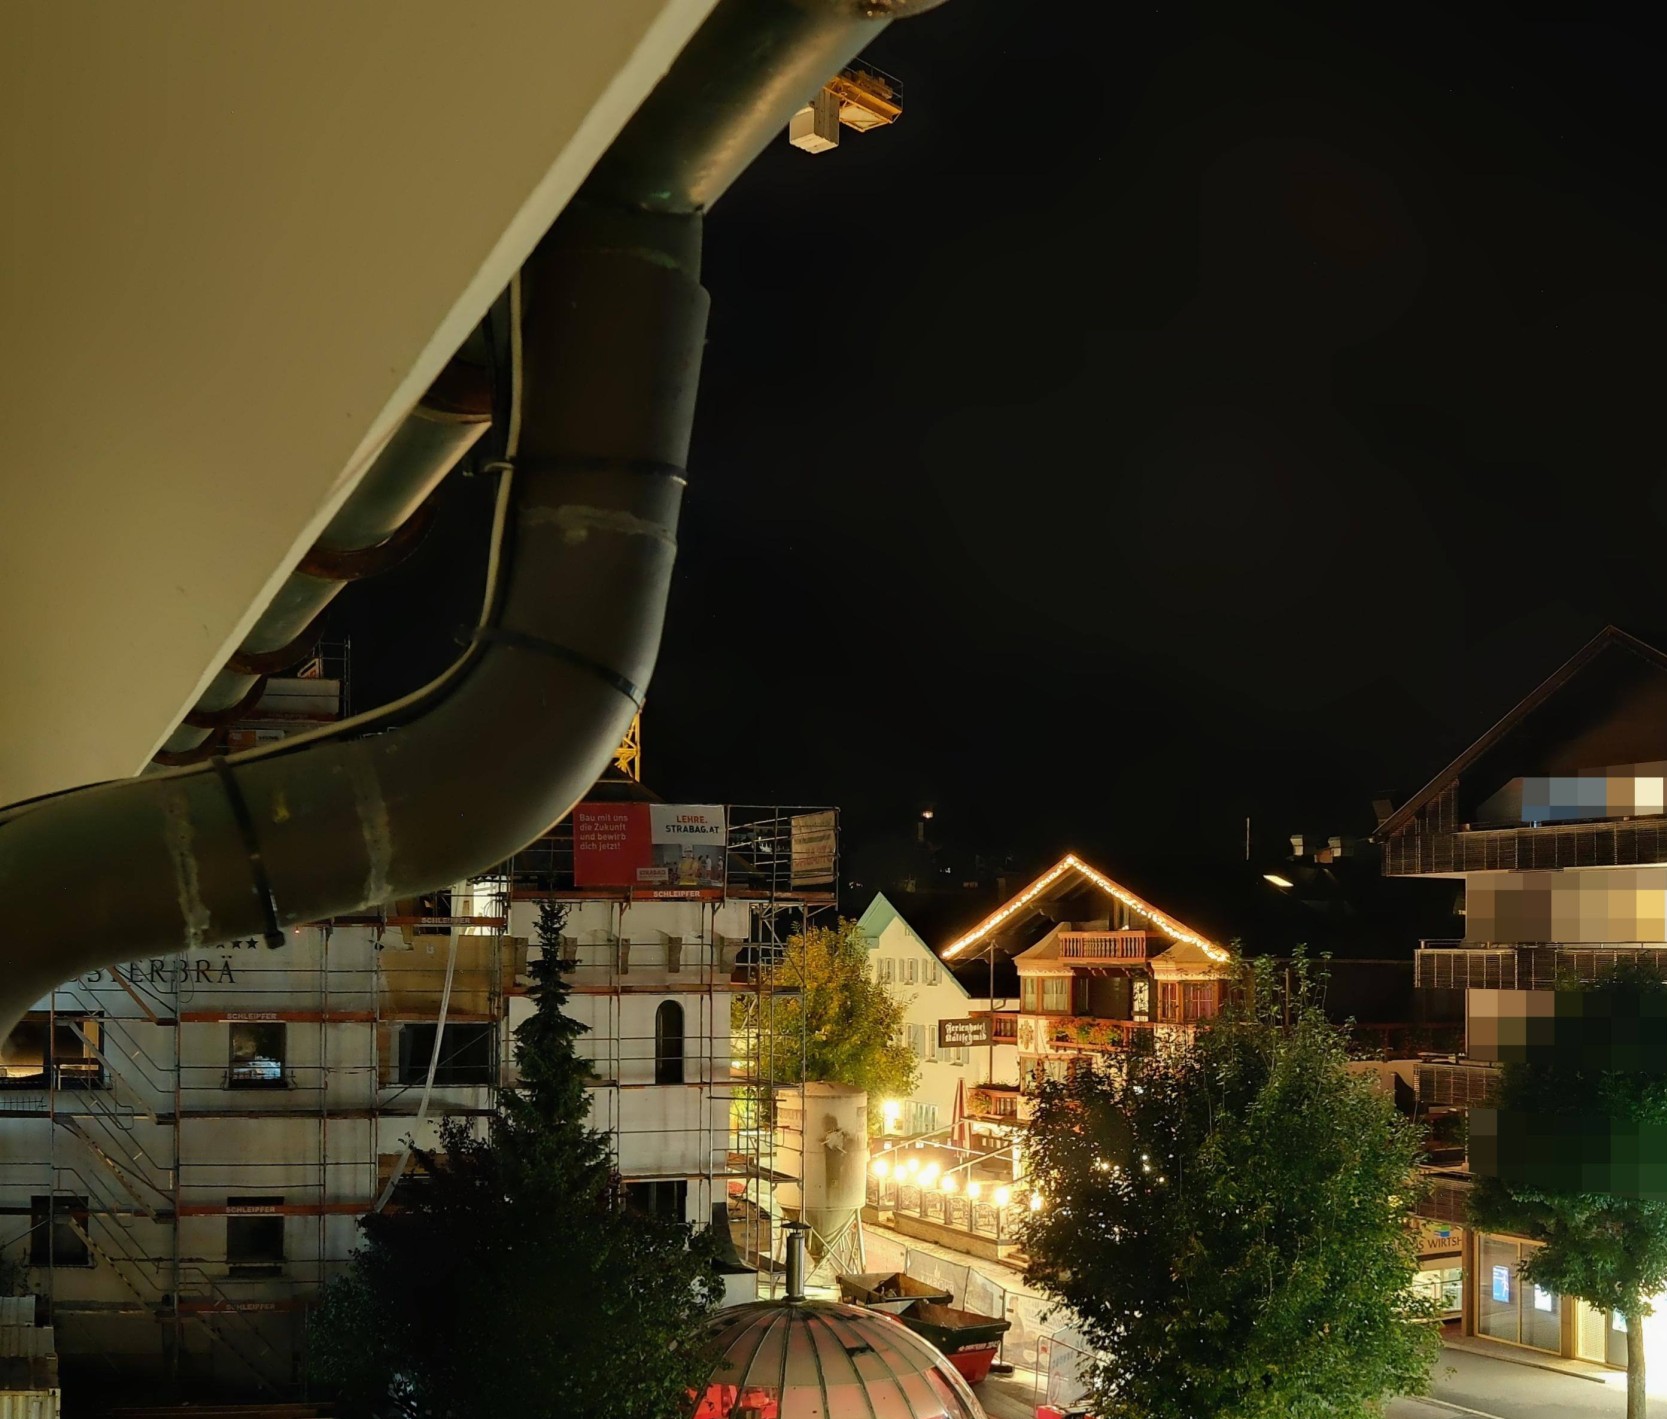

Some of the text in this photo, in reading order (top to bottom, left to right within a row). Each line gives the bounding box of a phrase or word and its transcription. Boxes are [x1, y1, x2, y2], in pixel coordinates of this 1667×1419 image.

[579, 813, 629, 822] Bau mit uns
[676, 815, 708, 824] LEHRE.
[579, 823, 626, 832] die Zukunft
[665, 824, 720, 834] STRABAG.AT
[579, 832, 627, 841] und bewirb
[579, 841, 621, 852] dich jetzt!
[653, 890, 701, 898] SCHLEIPFER
[420, 916, 471, 924] SCHLEIPFER
[226, 1012, 278, 1020] SCHLEIPFER
